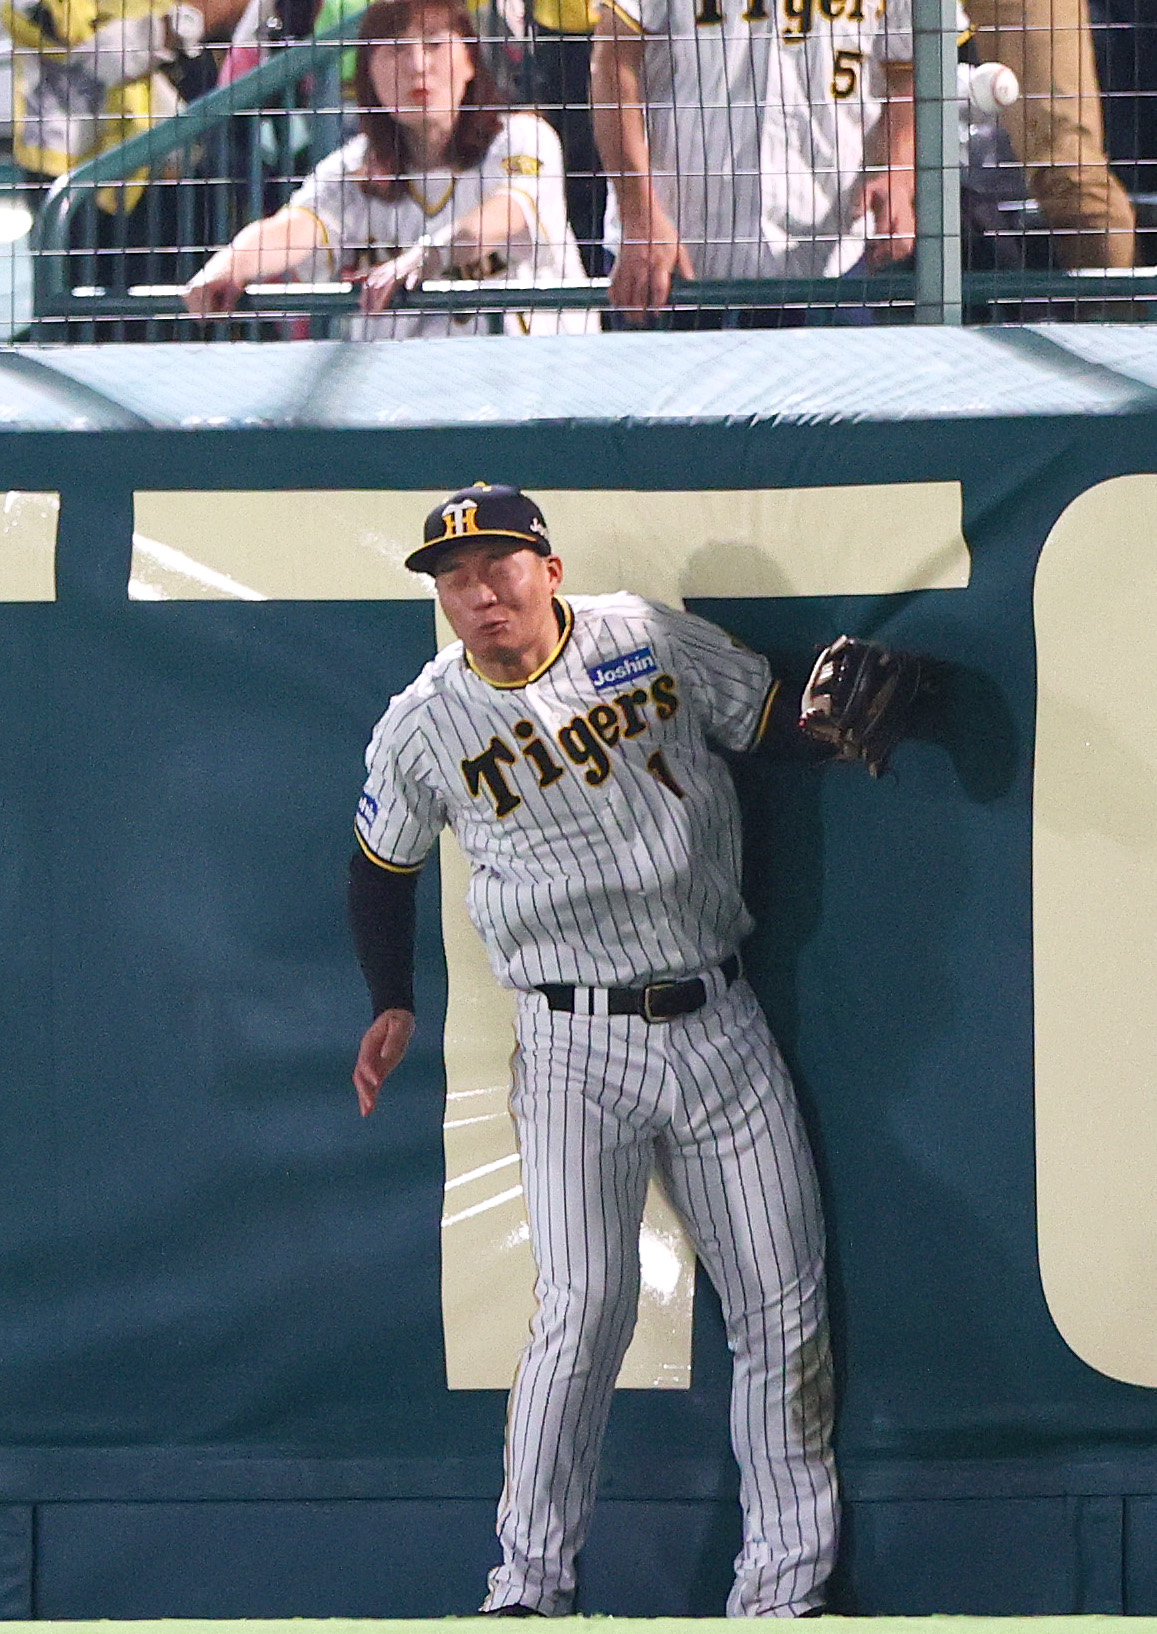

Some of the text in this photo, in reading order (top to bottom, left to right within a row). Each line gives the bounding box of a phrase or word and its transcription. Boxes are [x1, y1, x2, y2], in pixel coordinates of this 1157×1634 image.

[831, 50, 864, 98] 5
[594, 655, 654, 686] Joshin
[461, 674, 680, 818] Tigers
[647, 751, 686, 799] 1
